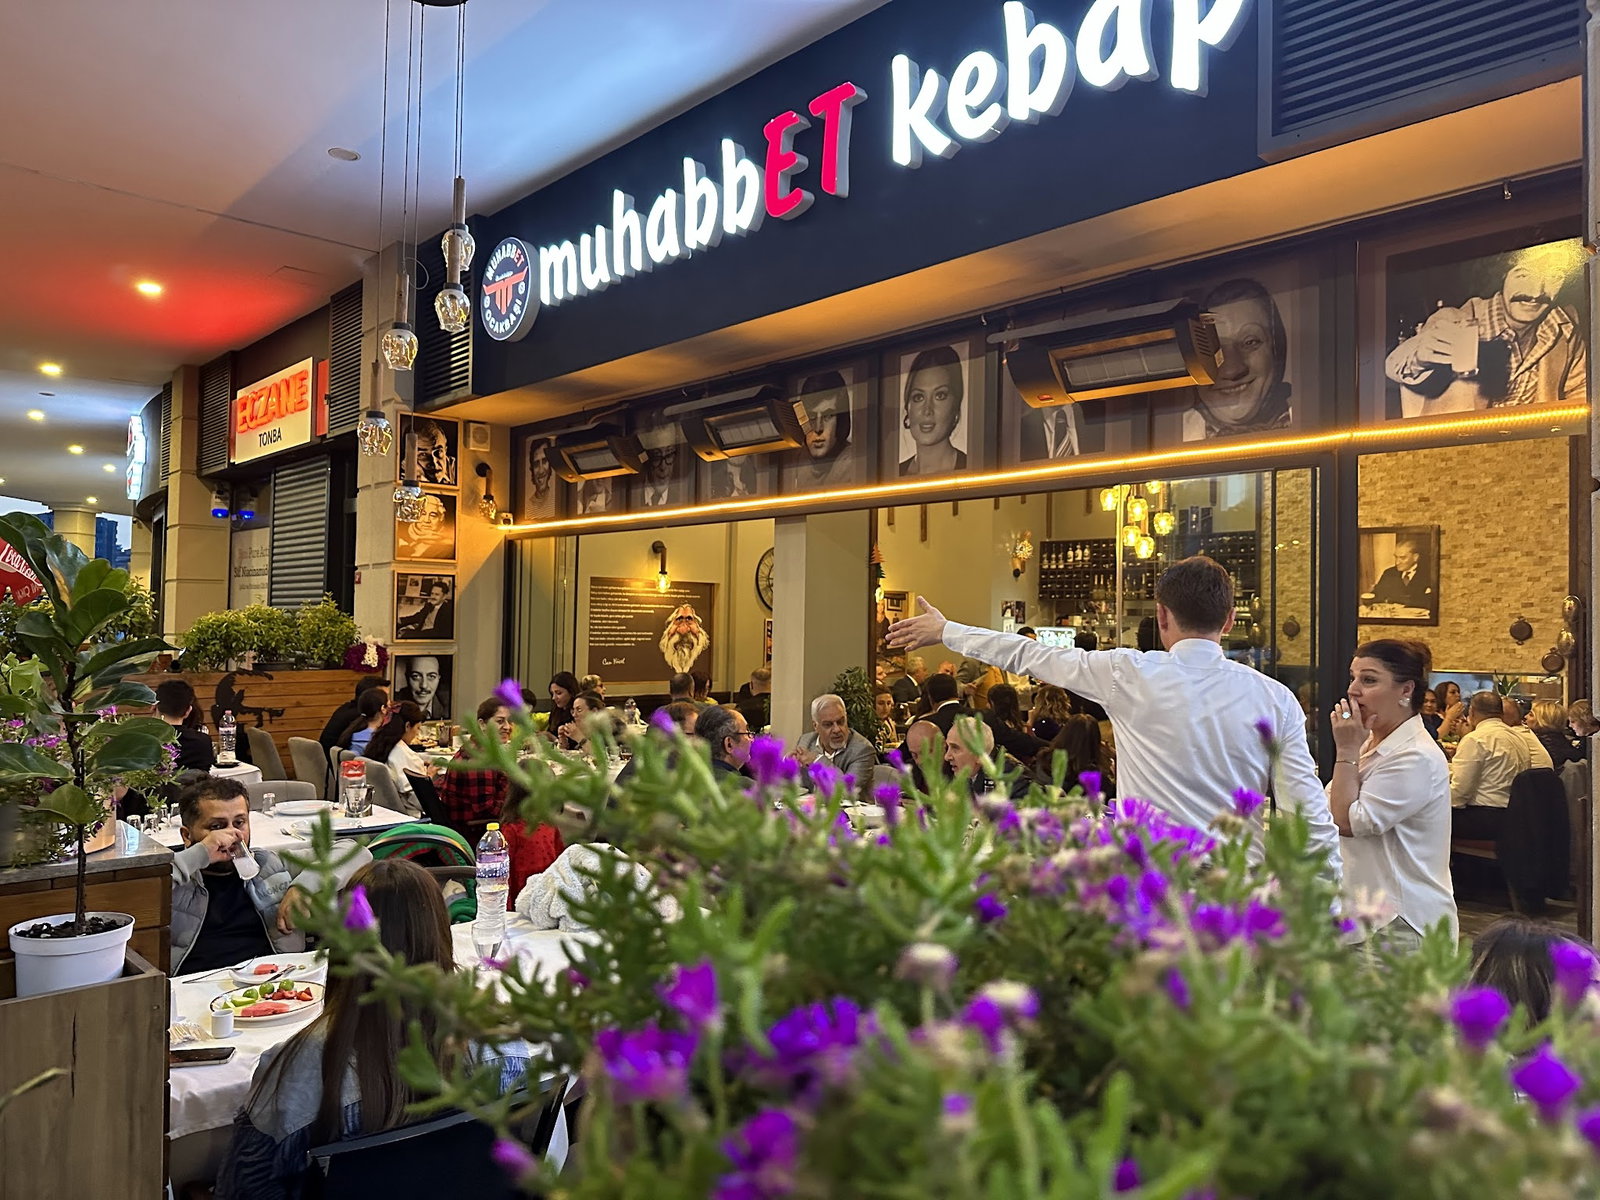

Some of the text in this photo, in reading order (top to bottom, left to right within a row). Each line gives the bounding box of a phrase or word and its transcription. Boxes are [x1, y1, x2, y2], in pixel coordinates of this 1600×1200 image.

[540, 0, 1248, 306] muhabbET kebap
[485, 243, 525, 281] MUHABBET
[237, 369, 309, 434] ECZANE
[258, 427, 282, 447] TONBA
